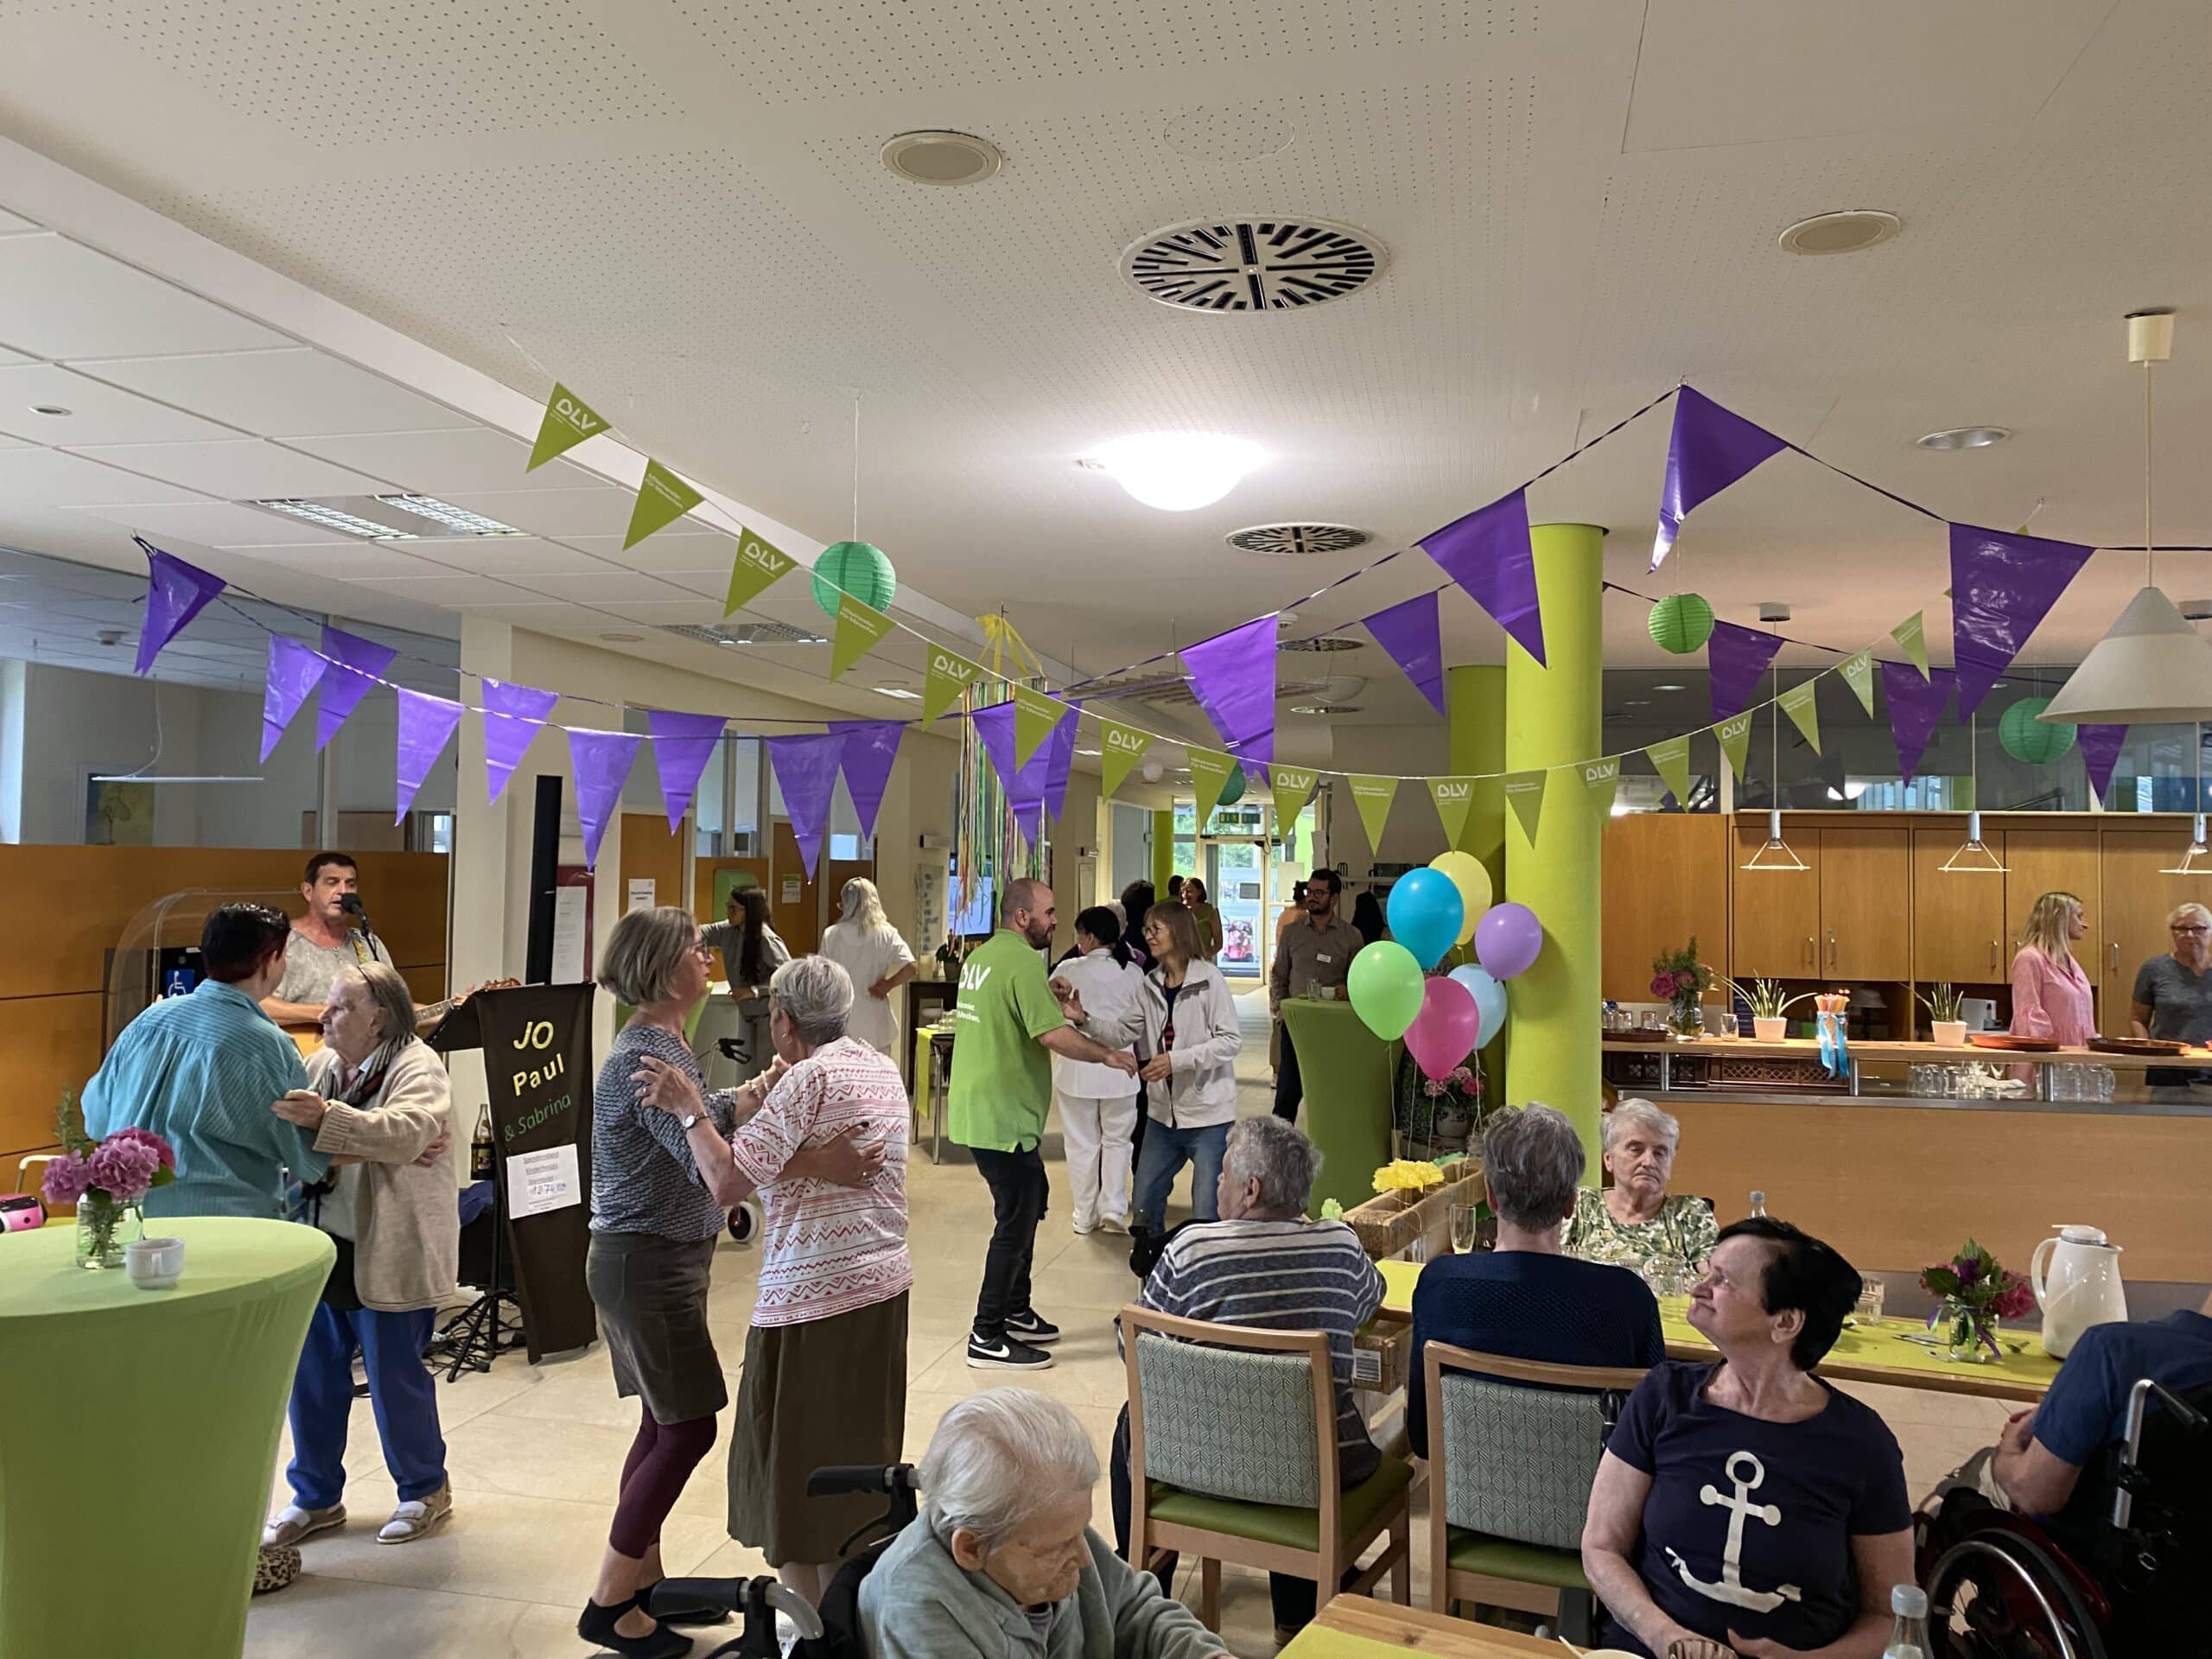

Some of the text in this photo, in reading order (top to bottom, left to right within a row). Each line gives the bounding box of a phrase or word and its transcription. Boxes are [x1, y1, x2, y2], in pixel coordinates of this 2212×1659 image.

[556, 398, 597, 429] DLV
[745, 542, 785, 570] DLV
[933, 655, 971, 679] DLV
[1847, 654, 1867, 677] DLV
[1108, 730, 1144, 751] DLV
[1722, 718, 1747, 740] DLV
[1276, 772, 1310, 789] DLV
[1586, 763, 1614, 781] DLV
[1438, 783, 1468, 798] DLV
[513, 1020, 554, 1050] JO
[512, 1052, 564, 1096] Paul
[505, 1094, 572, 1142] & Sabrina
